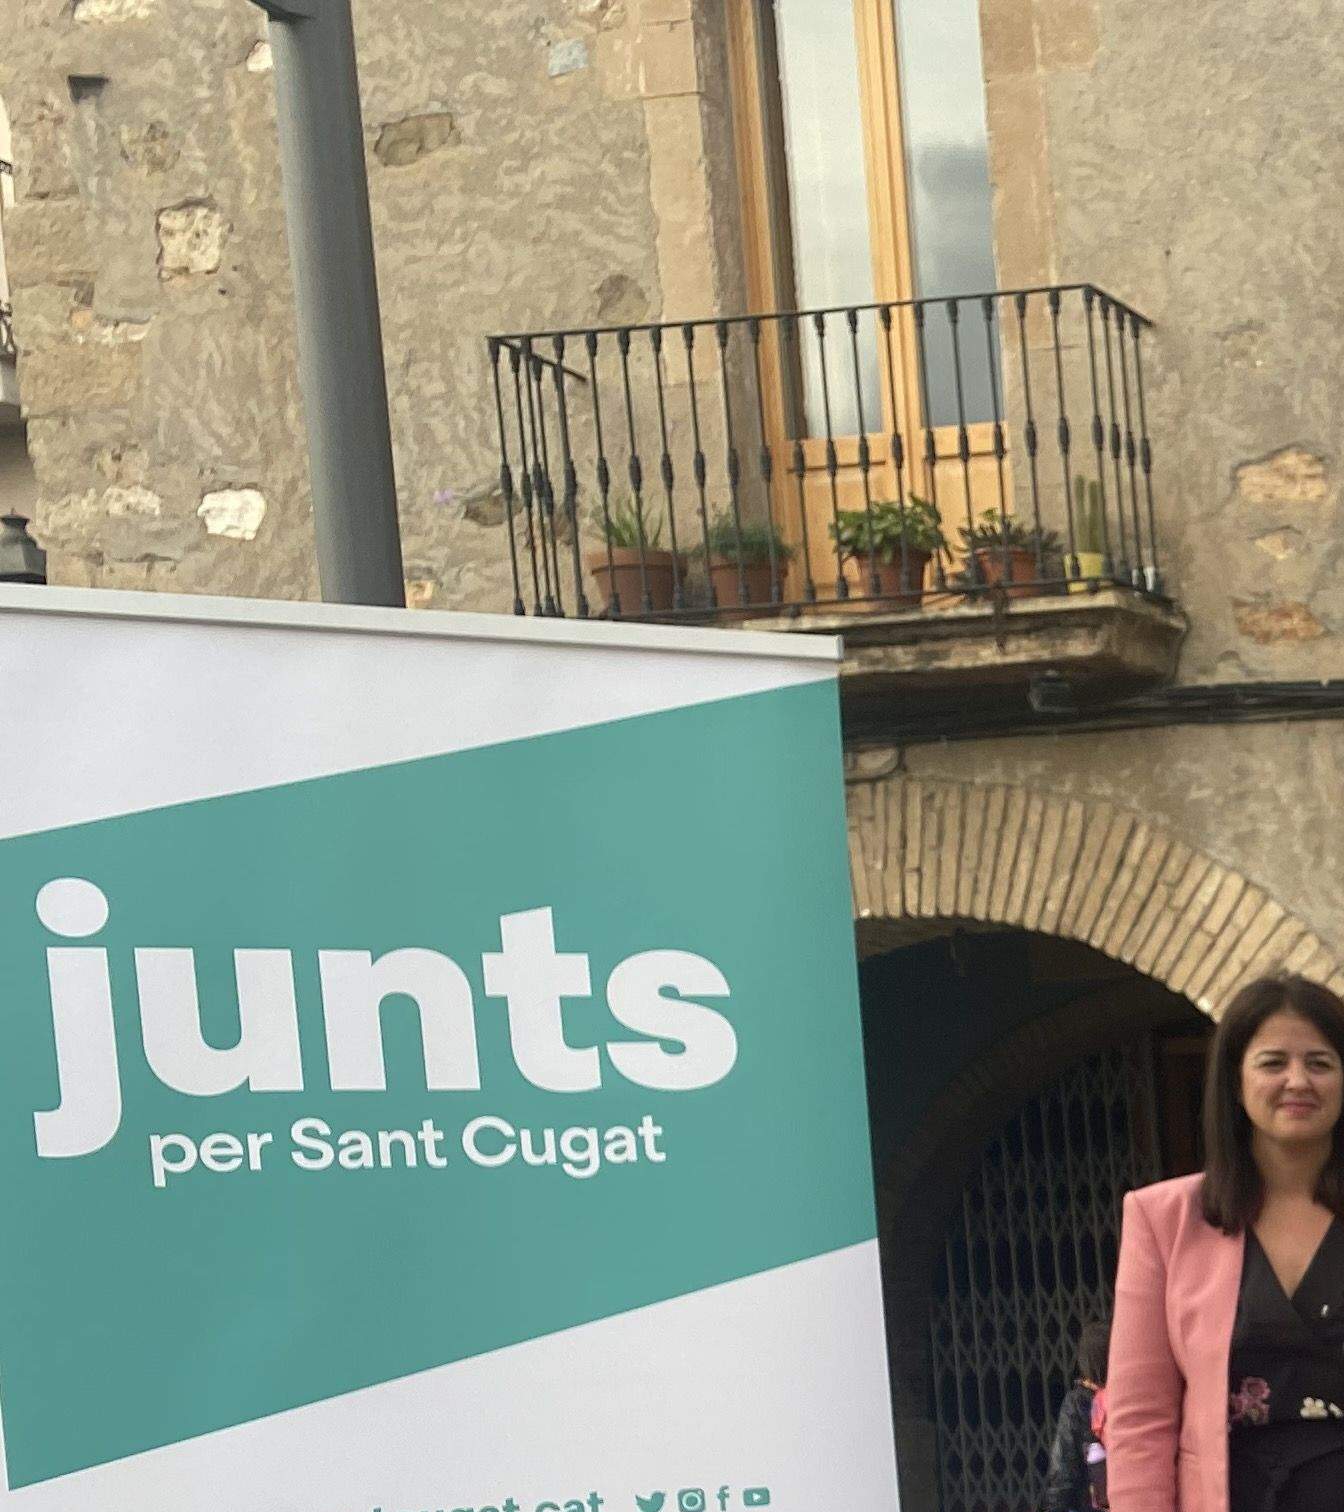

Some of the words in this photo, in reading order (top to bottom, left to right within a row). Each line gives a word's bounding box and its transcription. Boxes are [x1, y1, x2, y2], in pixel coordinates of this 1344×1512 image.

[34, 877, 738, 1159] junts
[149, 1130, 273, 1187] per
[290, 1117, 448, 1170] Sant
[461, 1114, 667, 1179] Cugat
